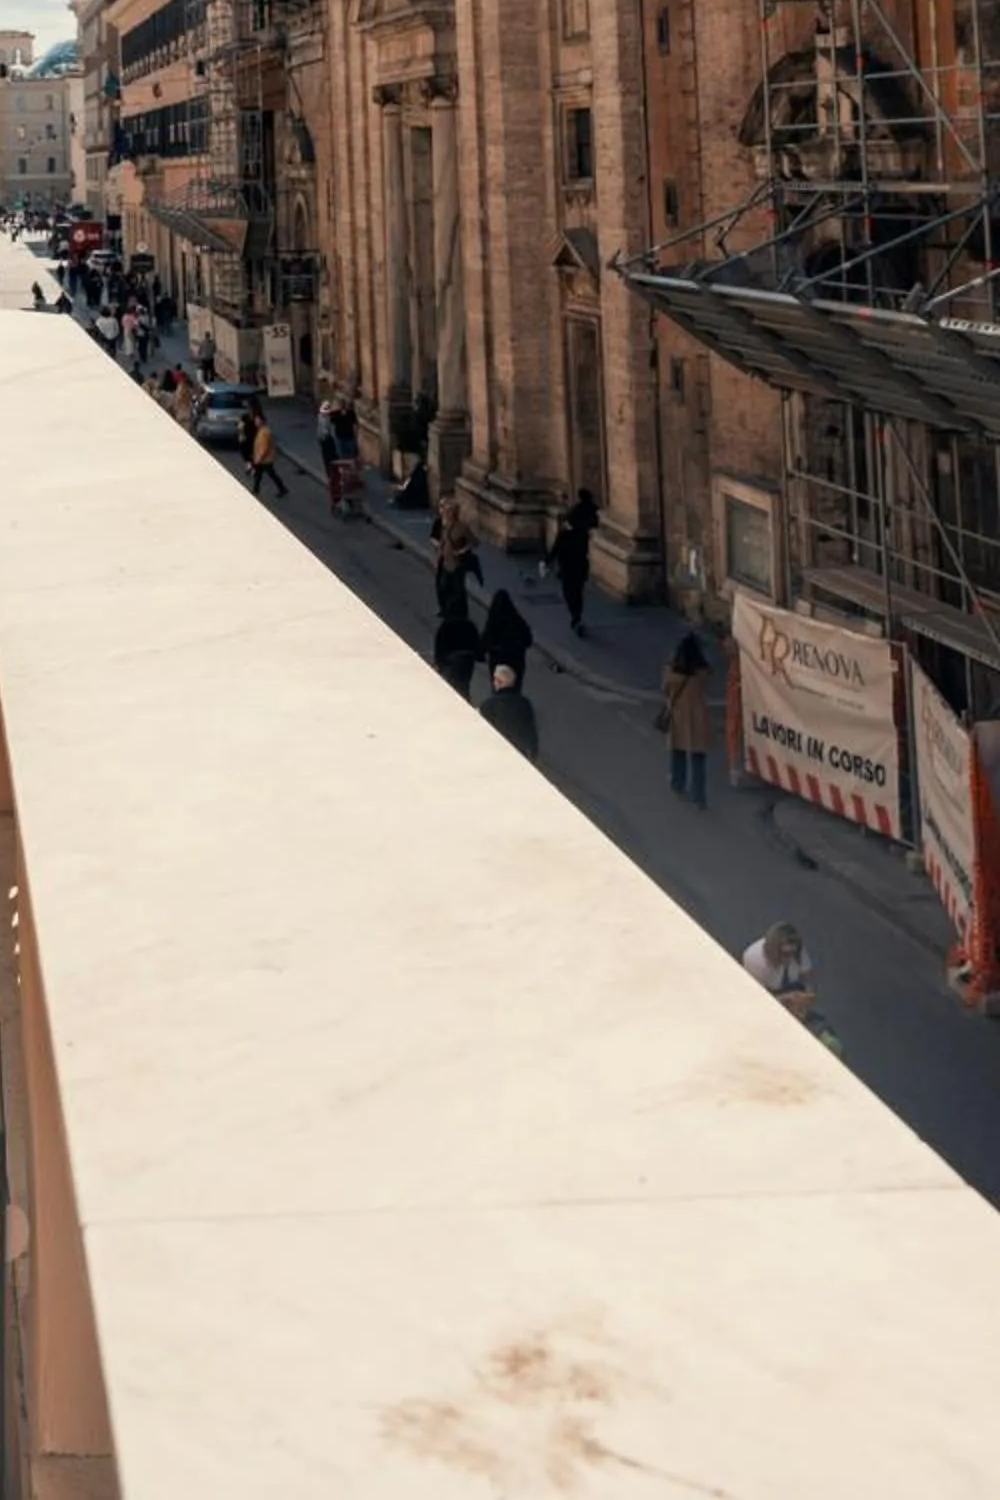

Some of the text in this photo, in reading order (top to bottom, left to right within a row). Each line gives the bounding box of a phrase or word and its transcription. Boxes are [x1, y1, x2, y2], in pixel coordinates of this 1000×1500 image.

[793, 638, 866, 688] RENOVA
[752, 710, 803, 753] LAVORI
[807, 736, 824, 763] IN
[828, 745, 886, 788] CORSO
